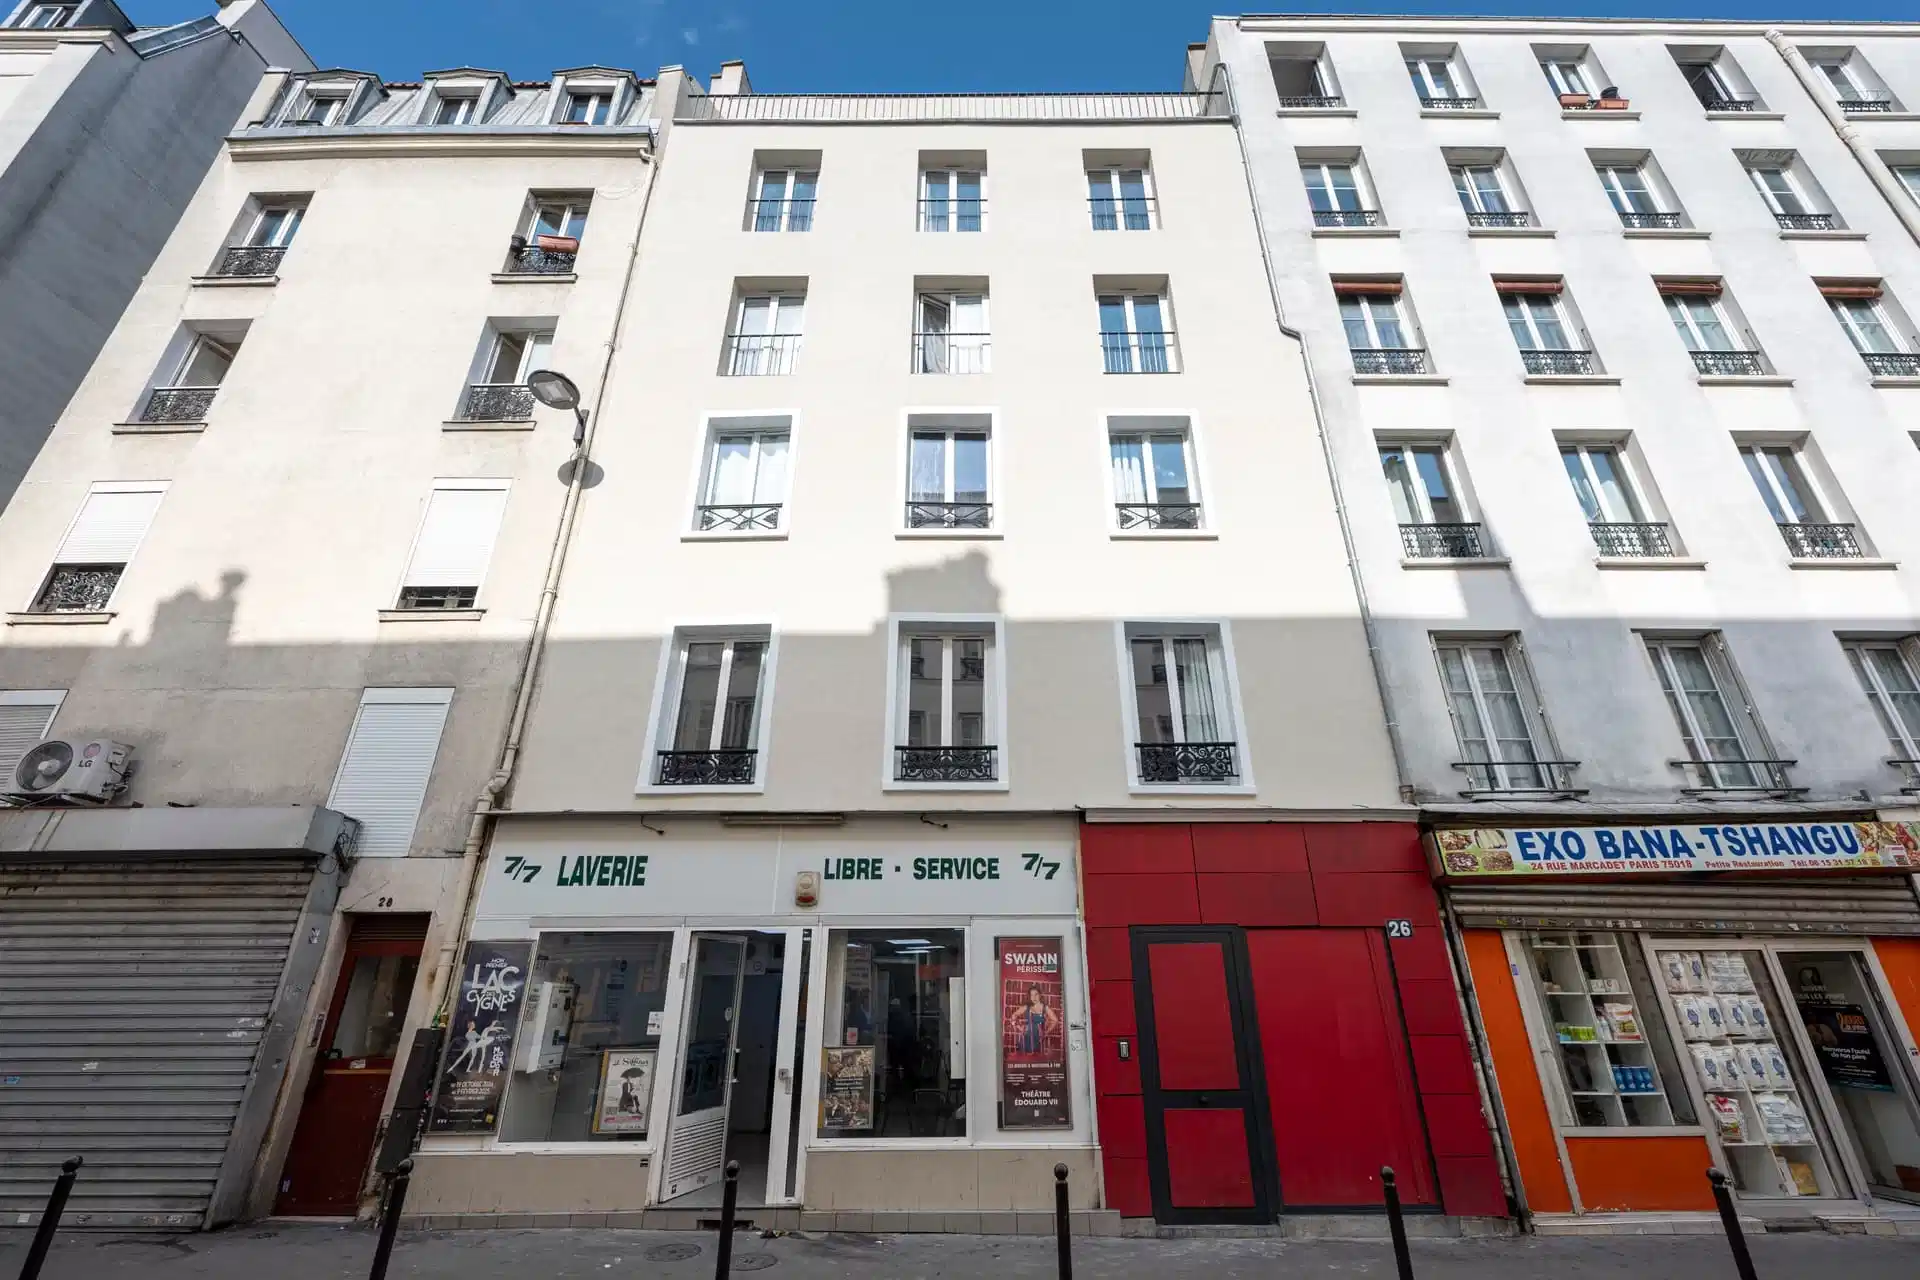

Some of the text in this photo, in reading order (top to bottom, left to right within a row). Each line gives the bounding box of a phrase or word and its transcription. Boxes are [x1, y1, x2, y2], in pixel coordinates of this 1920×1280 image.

[78, 759, 93, 768] LG
[1515, 825, 1859, 861] EXO BANA-TSHANGU
[503, 855, 649, 887] 7/7 LAVERIE
[823, 852, 1061, 880] LIBRE SERVICE 7/7
[1530, 859, 1693, 871] 24 RUE MARCADET PARIS 75018
[1388, 920, 1411, 937] 26
[1004, 952, 1058, 965] SWANN
[472, 963, 520, 994] LAC
[466, 989, 516, 1017] CYGNES
[1014, 1097, 1048, 1106] ÉDOUARD
[1021, 1089, 1052, 1098] THÉÂTRE
